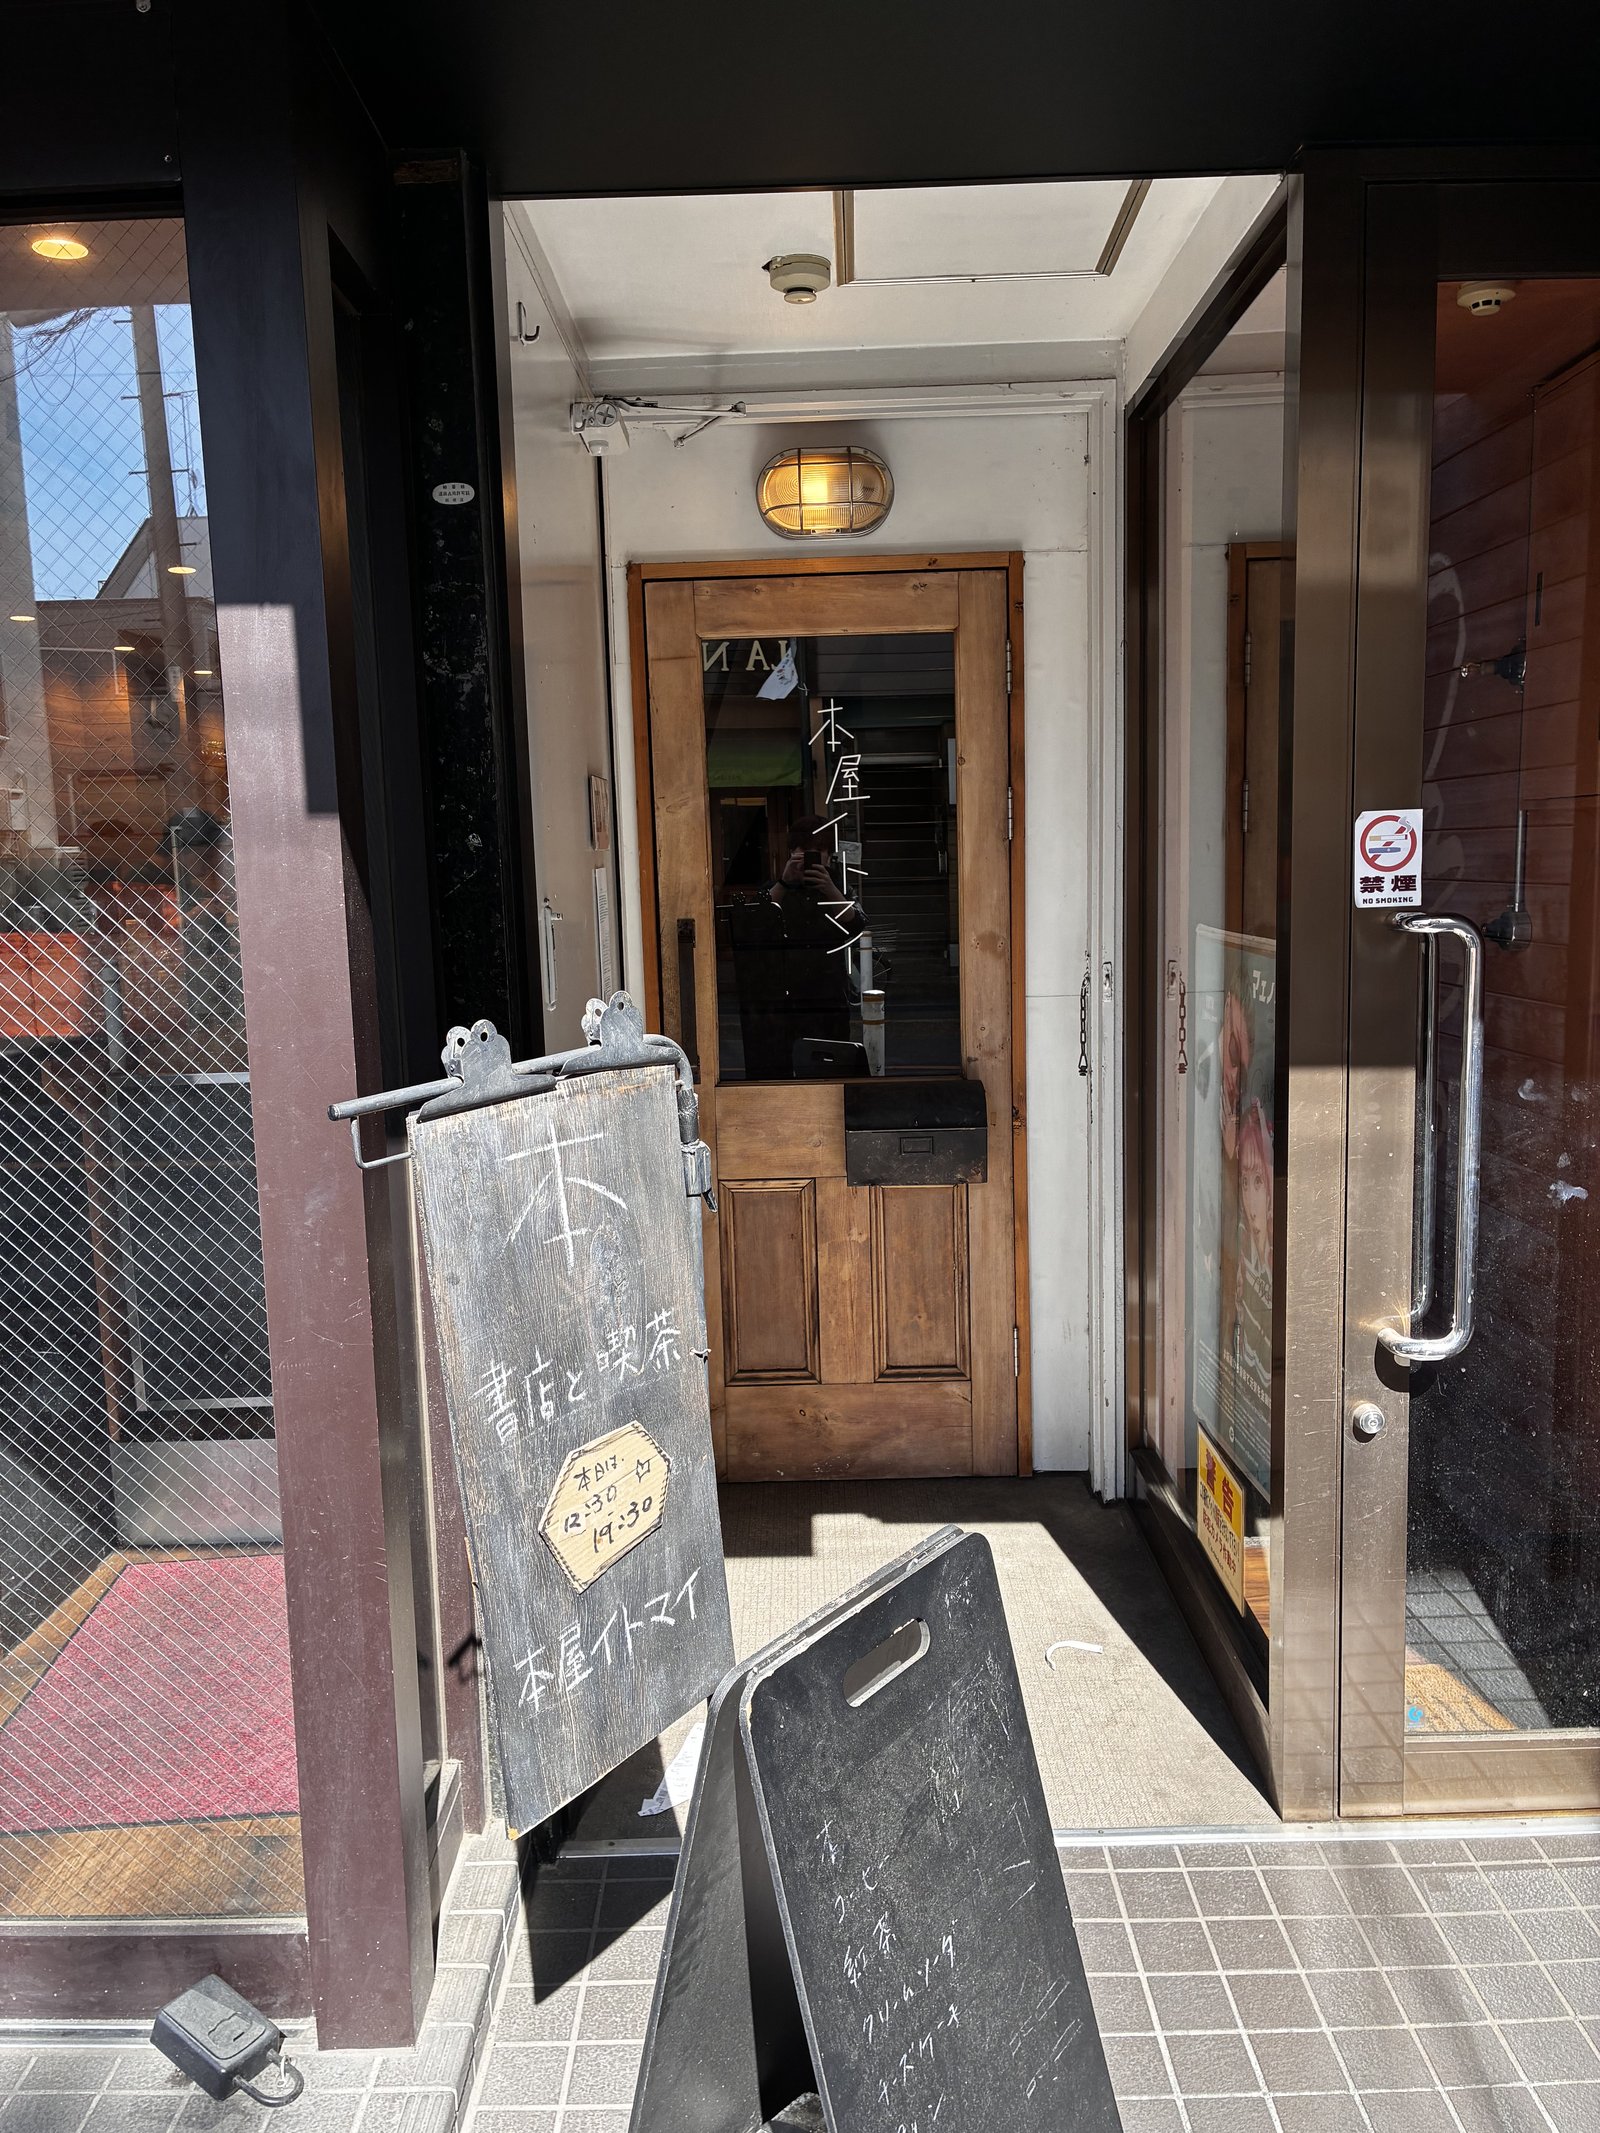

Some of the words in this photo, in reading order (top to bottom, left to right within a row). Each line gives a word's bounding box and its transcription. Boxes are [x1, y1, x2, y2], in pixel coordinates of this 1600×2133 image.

[808, 697, 871, 975] 本屋イトマイ
[1360, 875, 1417, 893] 禁煙
[1363, 897, 1374, 905] NO
[1375, 896, 1414, 904] SMOKING
[498, 1118, 628, 1274] 本
[470, 1309, 681, 1446] 書店と喫茶
[593, 1495, 652, 1554] 19:30
[1206, 1448, 1235, 1524] 警告
[513, 1567, 701, 1711] 本屋イトマイ
